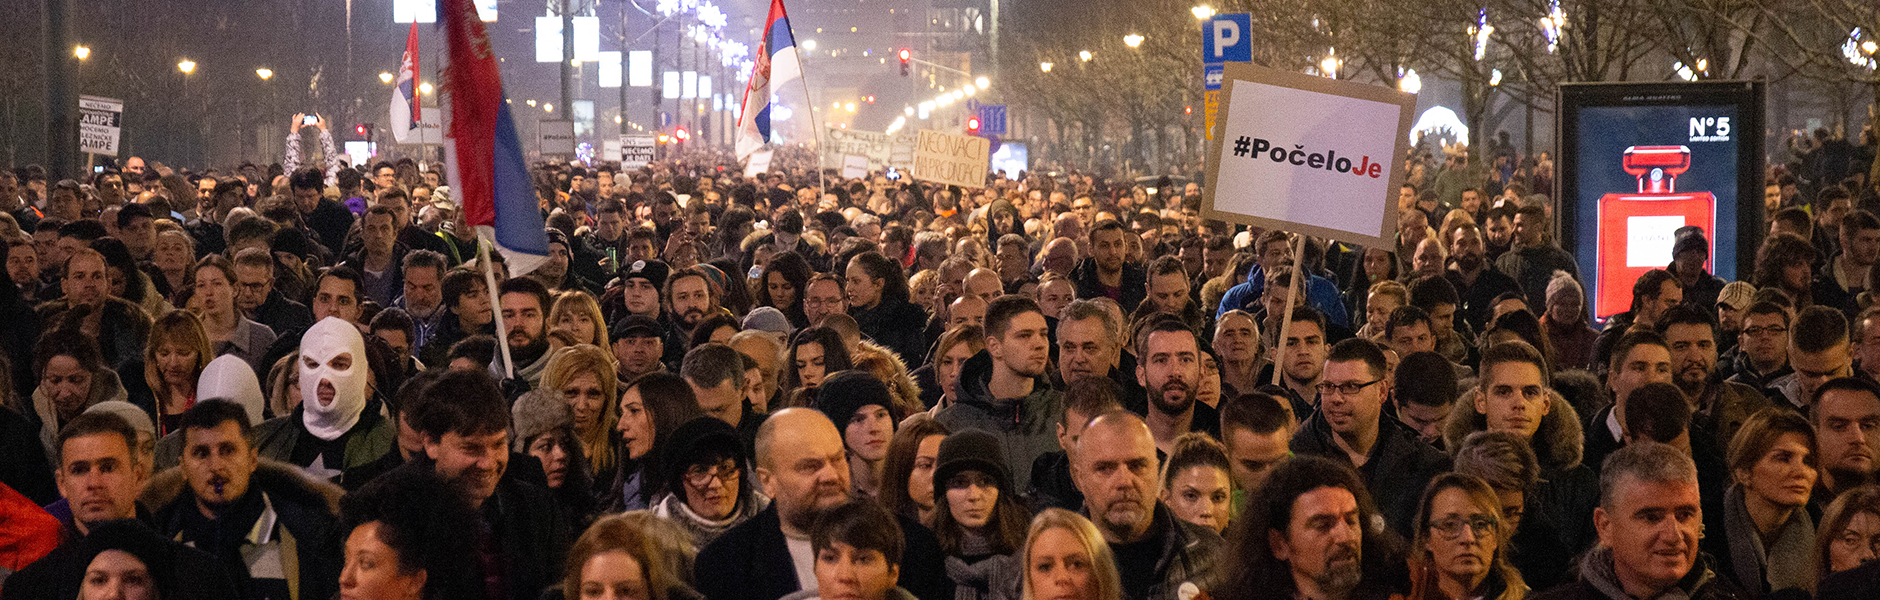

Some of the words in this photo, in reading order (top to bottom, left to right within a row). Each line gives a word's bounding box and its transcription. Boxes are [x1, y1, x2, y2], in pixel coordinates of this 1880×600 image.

[1213, 20, 1240, 57] P
[81, 113, 114, 126] AMPE
[81, 138, 112, 150] AMPE
[918, 130, 982, 160] NEONACI
[1233, 135, 1382, 179] #PočeloJe
